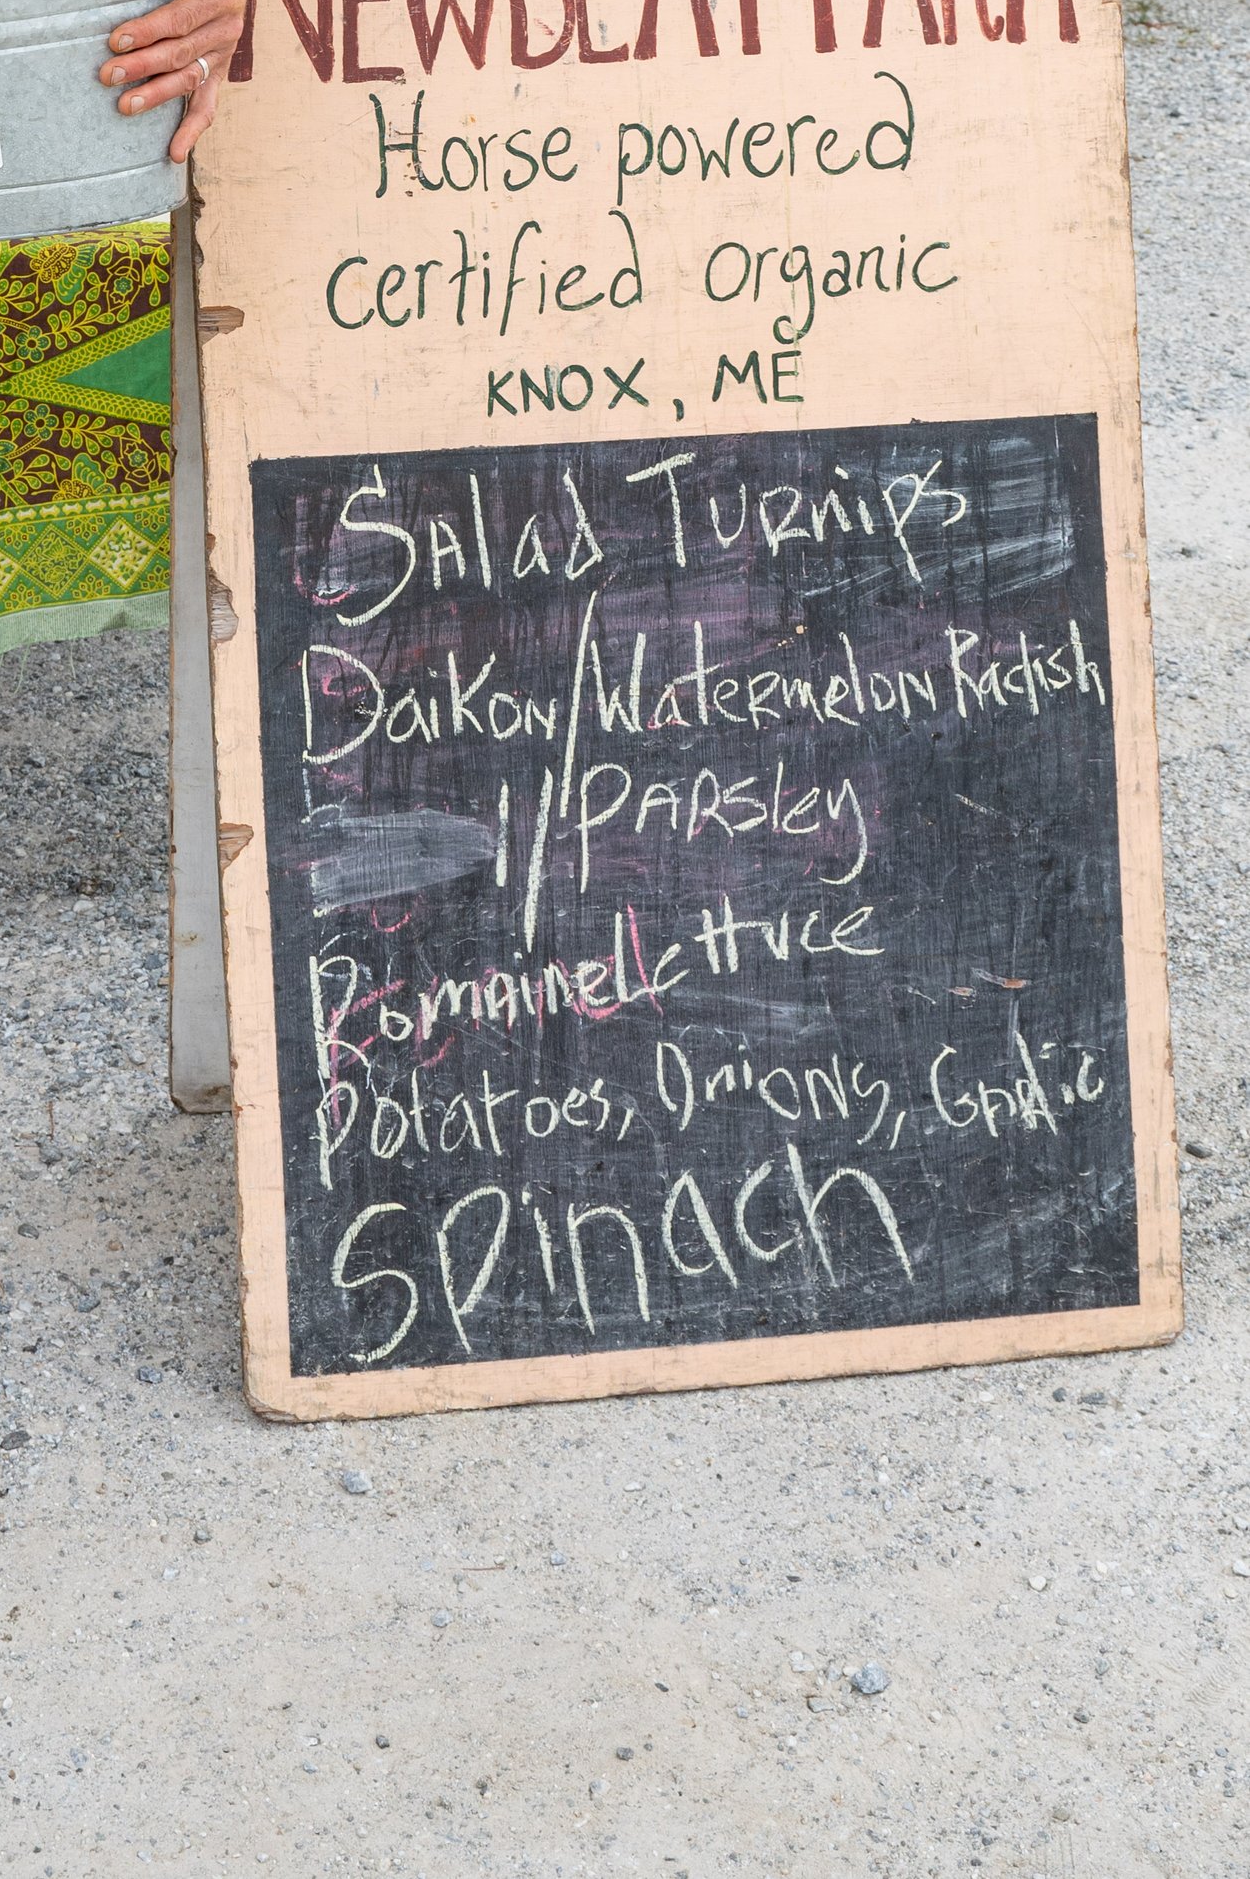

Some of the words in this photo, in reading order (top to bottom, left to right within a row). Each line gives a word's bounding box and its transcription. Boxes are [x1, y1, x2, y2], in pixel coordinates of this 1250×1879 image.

[369, 89, 579, 199] Horse
[616, 71, 916, 206] powered
[487, 357, 686, 422] KNOX,
[712, 350, 806, 405] ME
